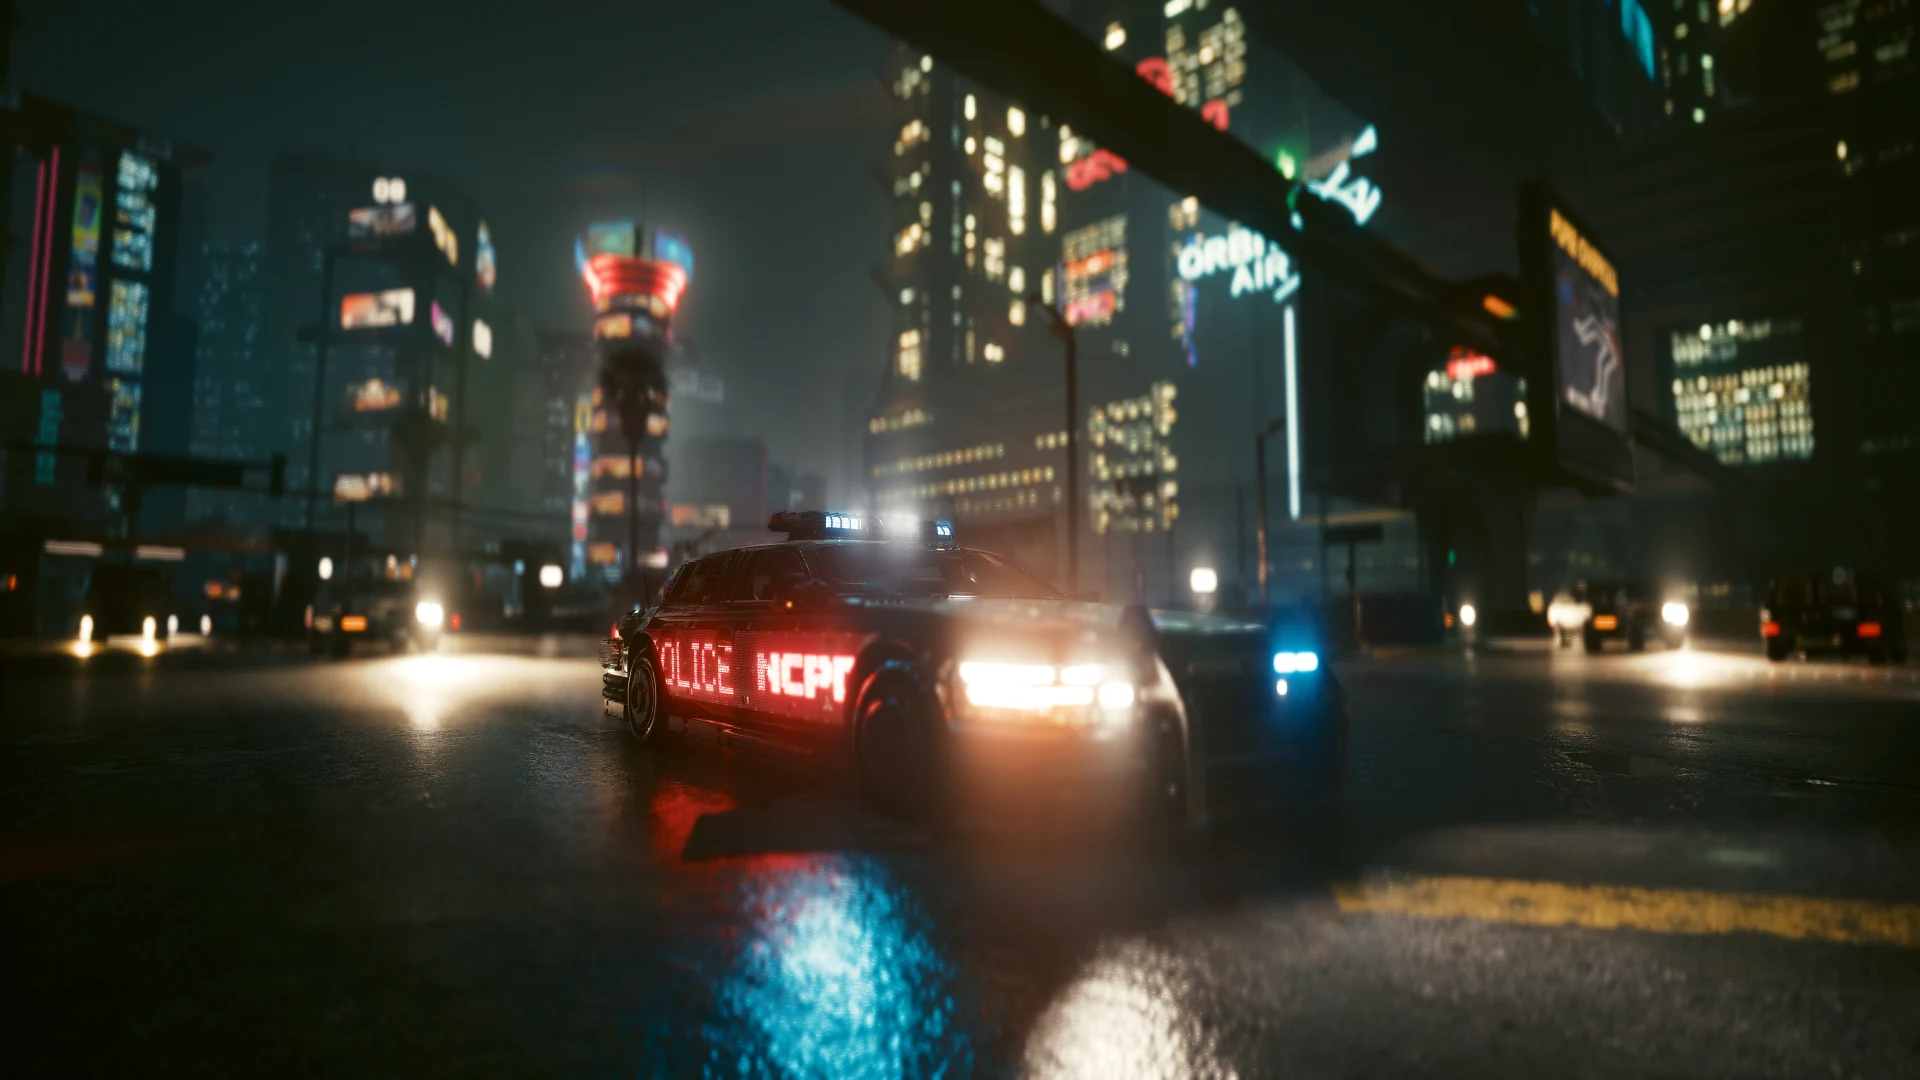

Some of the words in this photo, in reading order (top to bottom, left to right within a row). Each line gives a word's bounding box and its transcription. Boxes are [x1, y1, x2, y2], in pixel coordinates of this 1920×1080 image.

[1178, 227, 1266, 280] ORBI
[1230, 250, 1289, 298] AIR
[653, 638, 735, 695] OLICE
